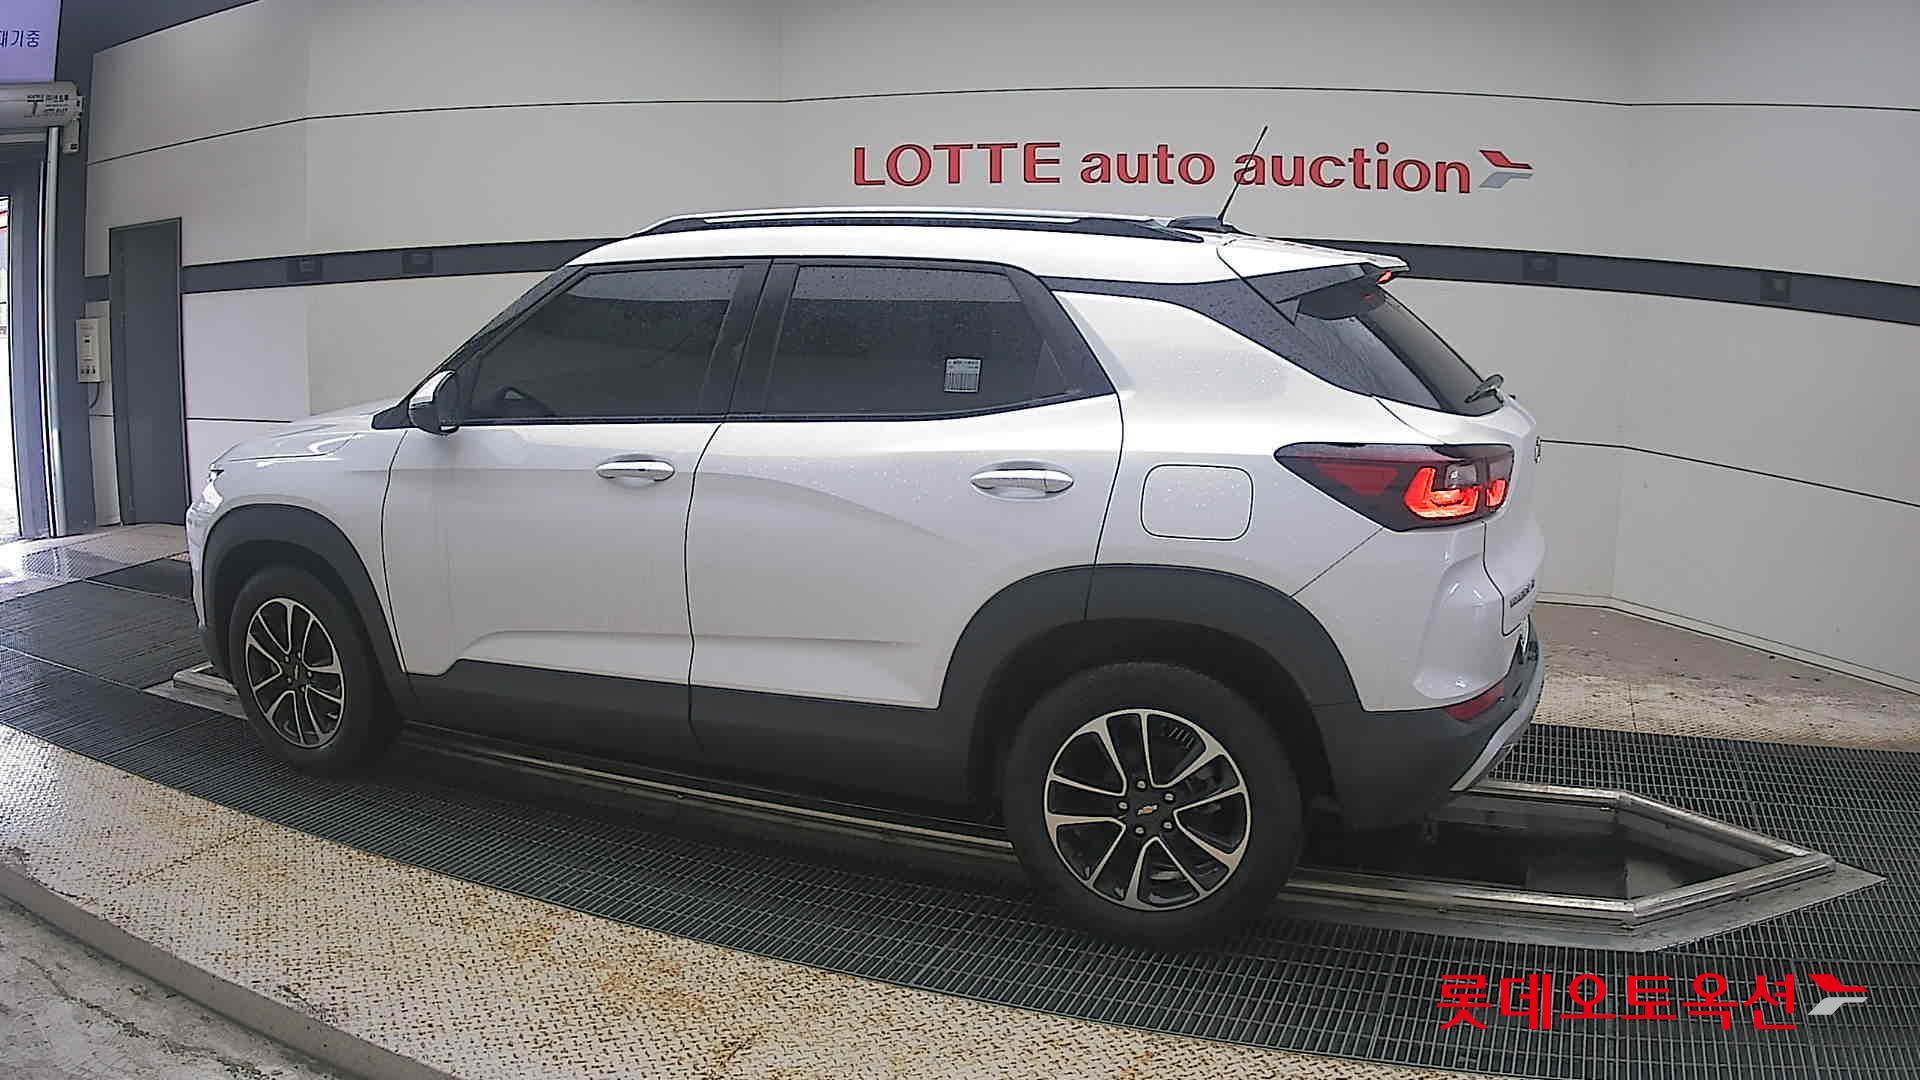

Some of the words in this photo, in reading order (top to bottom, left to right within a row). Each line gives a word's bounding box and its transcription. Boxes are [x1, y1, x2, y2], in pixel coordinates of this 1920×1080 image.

[853, 142, 1061, 186] LOTTE
[1079, 143, 1216, 185] auto
[1233, 141, 1471, 194] auction
